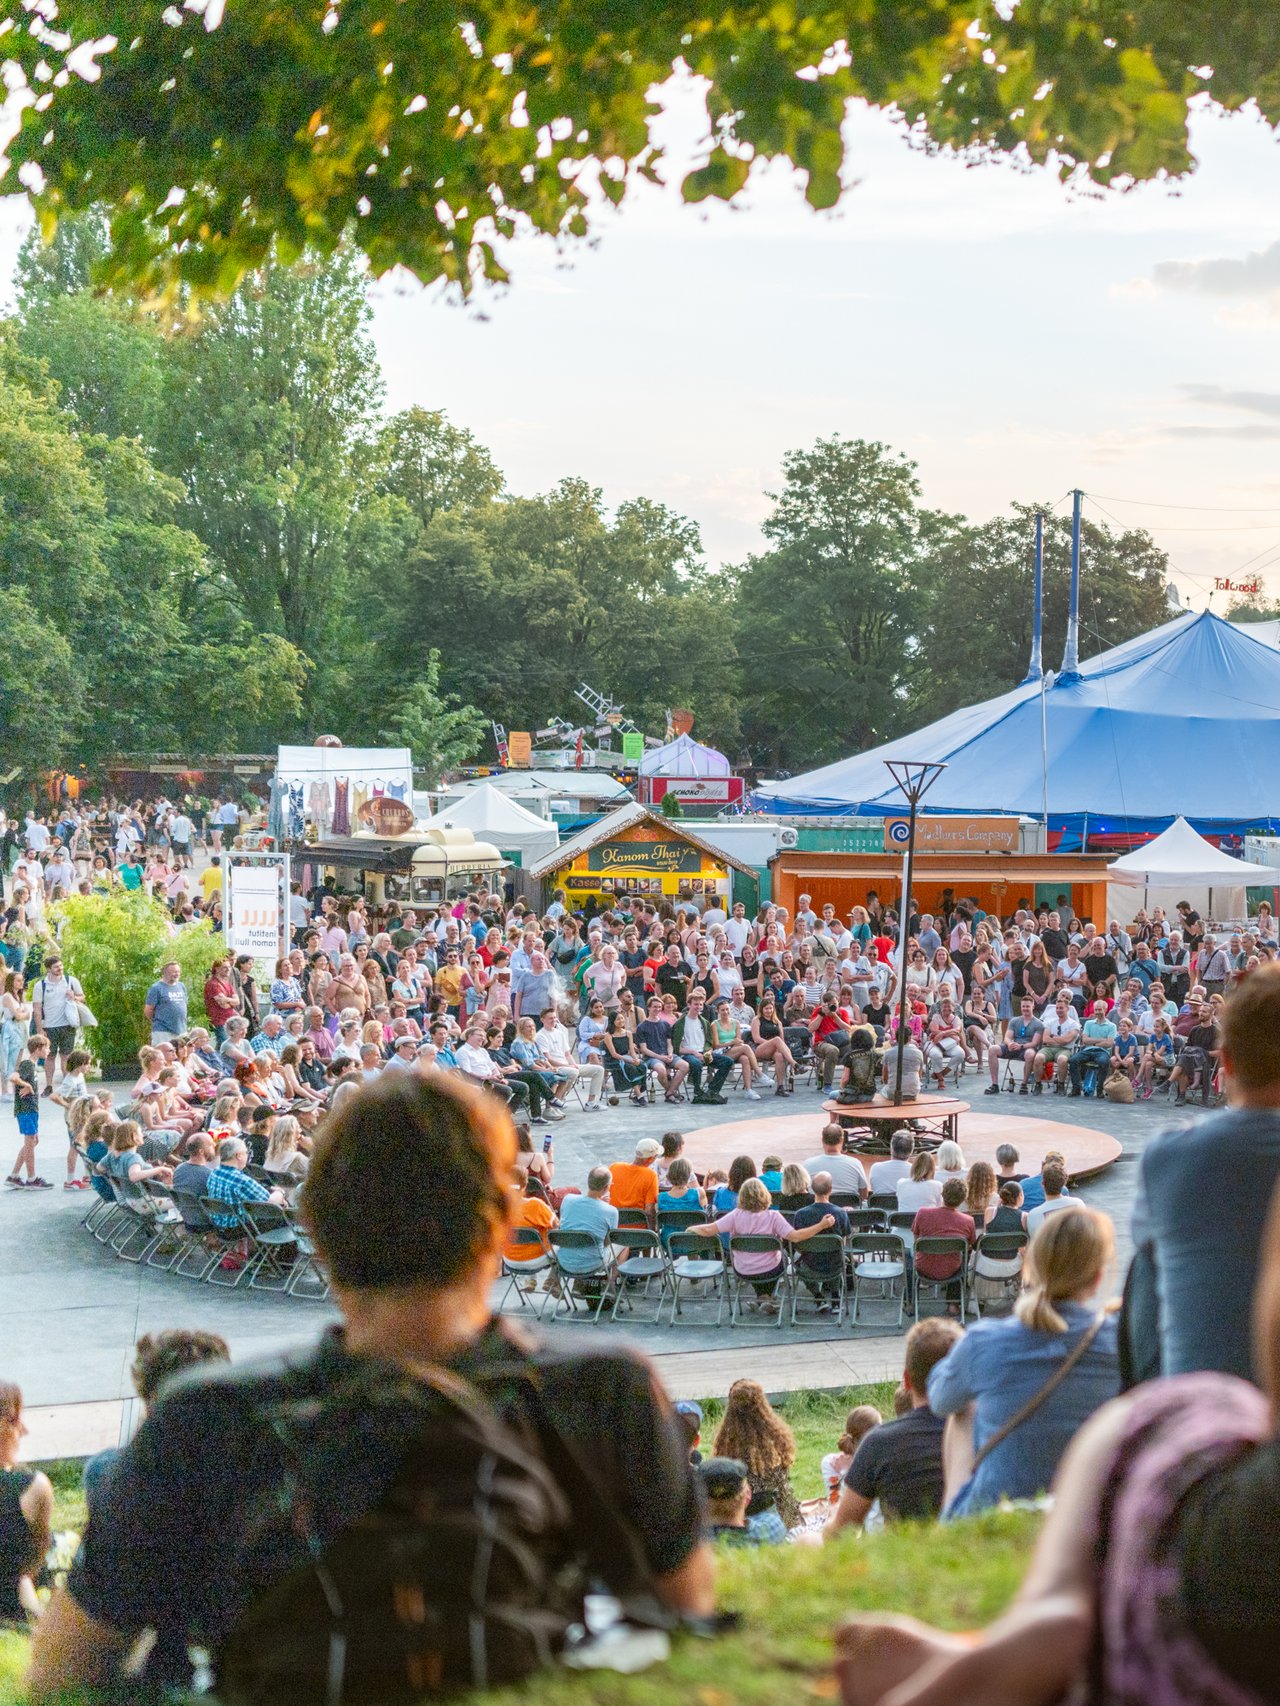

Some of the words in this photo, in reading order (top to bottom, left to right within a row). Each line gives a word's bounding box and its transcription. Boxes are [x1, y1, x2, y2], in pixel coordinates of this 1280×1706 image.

[966, 823, 1014, 847] Company
[602, 848, 649, 864] Kanom
[651, 844, 680, 860] Thai
[570, 878, 600, 888] Kasse
